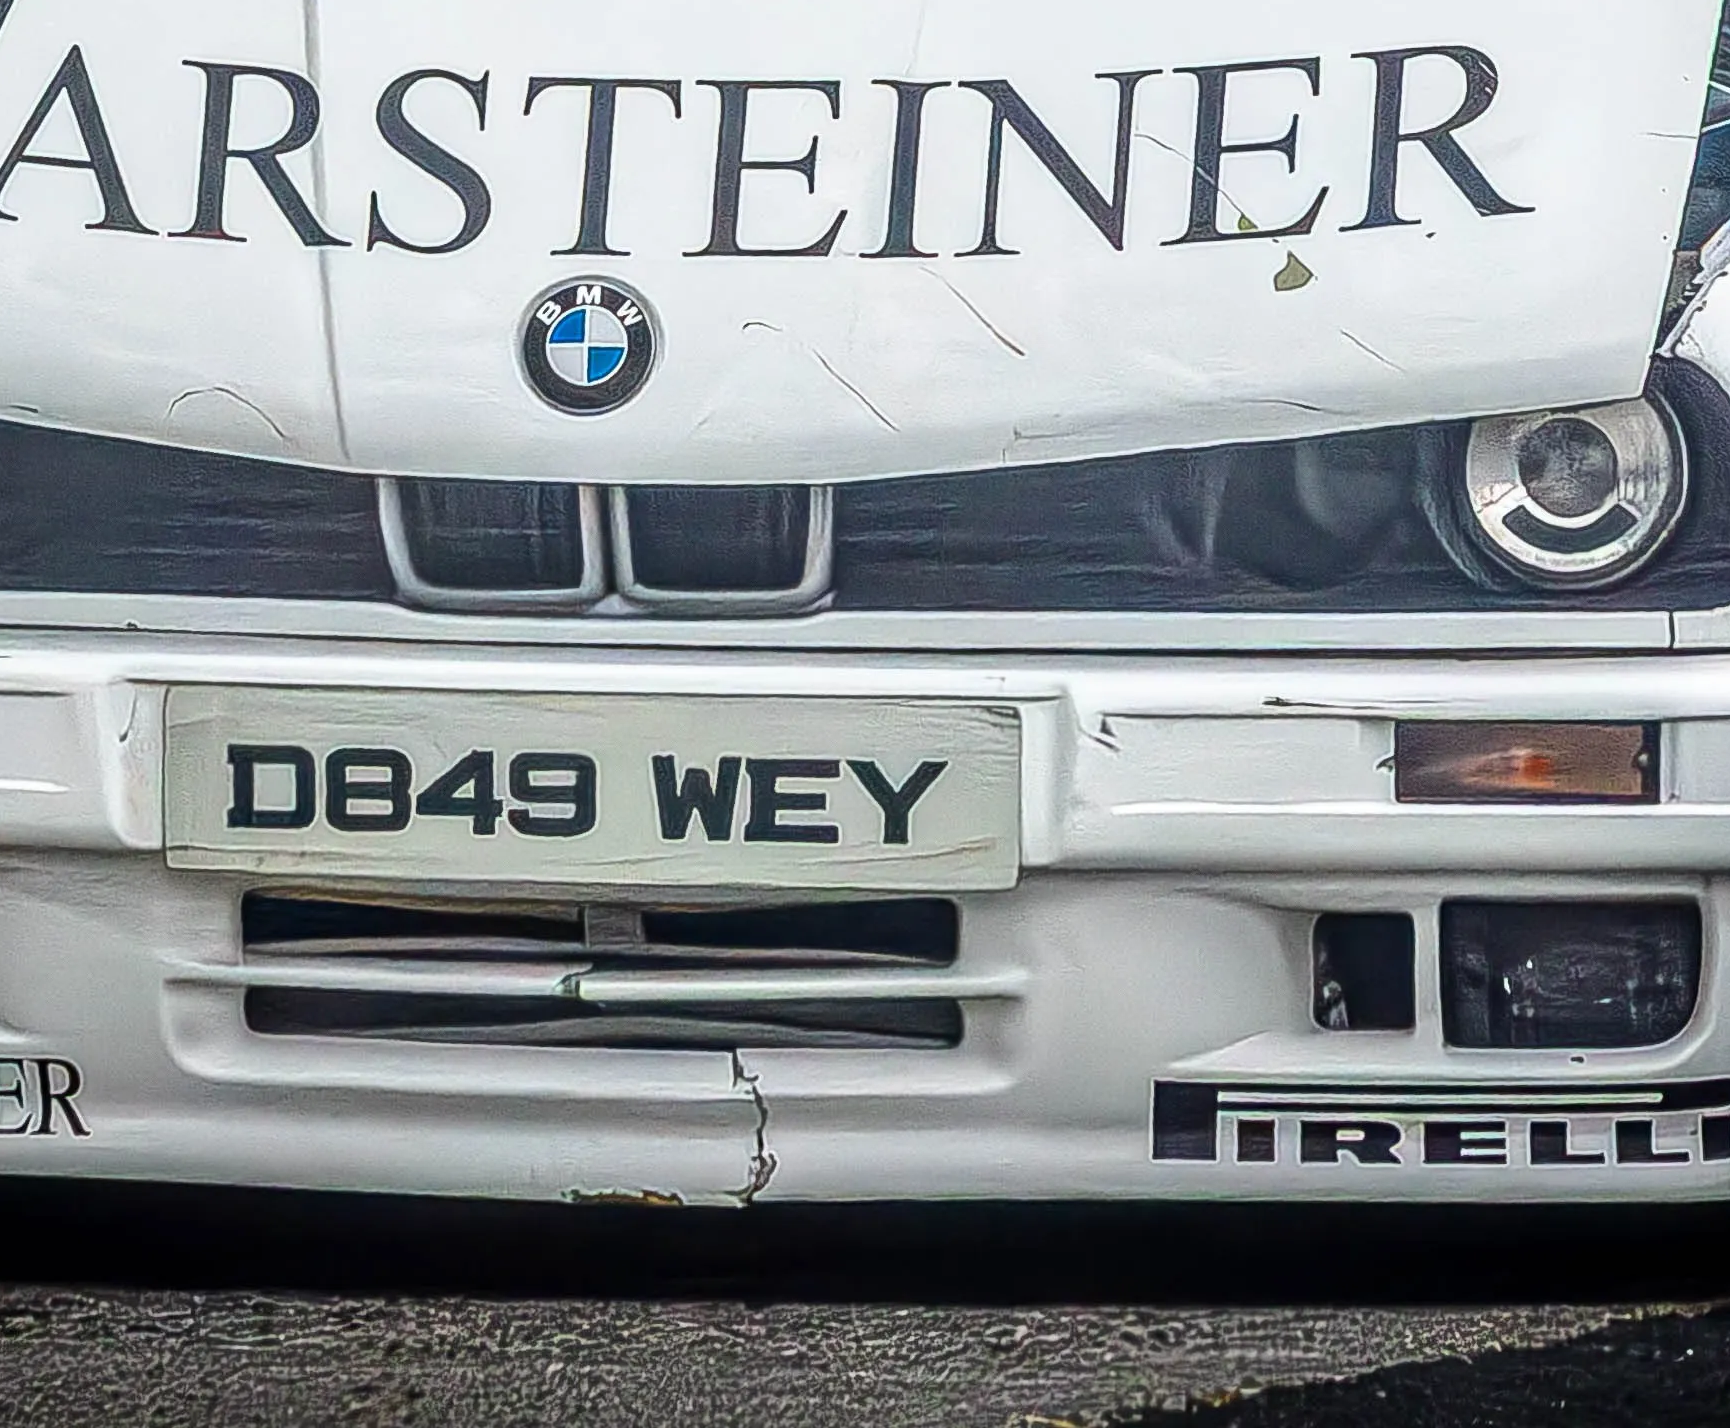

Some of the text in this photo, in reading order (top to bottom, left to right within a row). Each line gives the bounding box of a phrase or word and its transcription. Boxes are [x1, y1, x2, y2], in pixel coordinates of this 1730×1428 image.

[536, 285, 643, 326] BMW
[226, 743, 949, 845] D849 WEY
